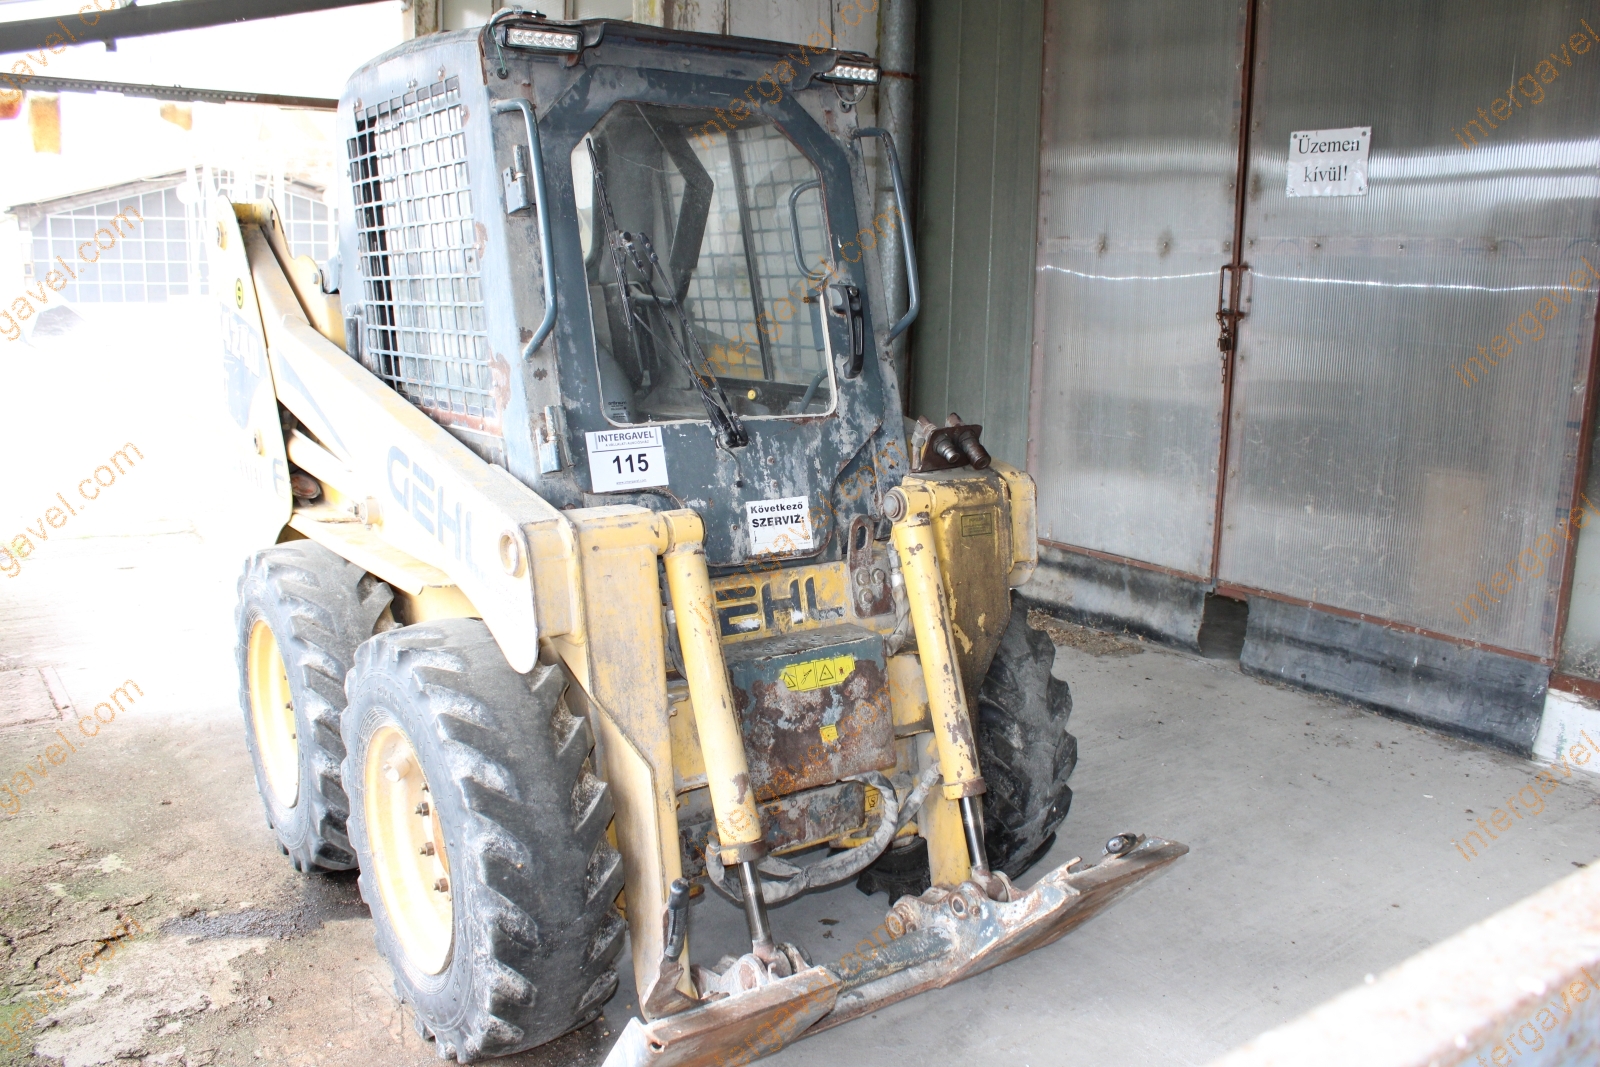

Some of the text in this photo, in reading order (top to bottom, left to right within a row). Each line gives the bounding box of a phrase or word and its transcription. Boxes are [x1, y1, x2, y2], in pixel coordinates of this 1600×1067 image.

[1298, 134, 1360, 154] Üzemen
[1303, 165, 1348, 182] kívül!
[597, 430, 654, 443] INTERGAVEL
[612, 453, 649, 474] 115
[387, 445, 489, 587] GEHL
[750, 501, 803, 514] Következő
[751, 514, 805, 528] SZERVIZ:
[714, 576, 846, 637] EHL
